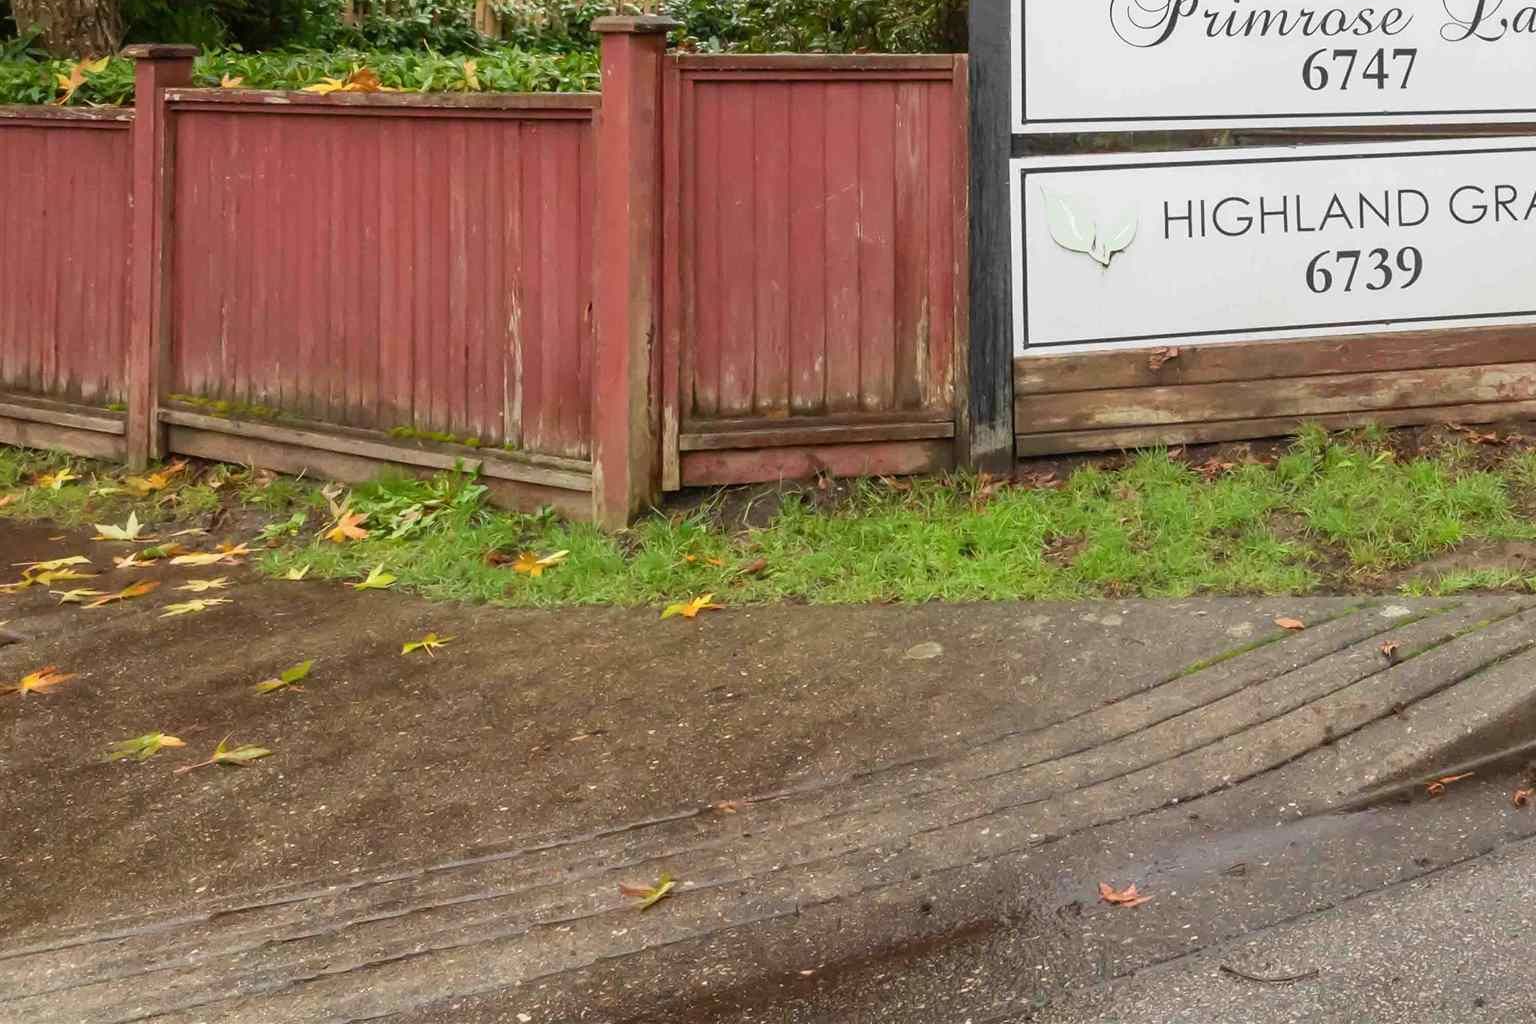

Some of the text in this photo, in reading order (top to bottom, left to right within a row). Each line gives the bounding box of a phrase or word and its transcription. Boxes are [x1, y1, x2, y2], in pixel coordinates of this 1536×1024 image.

[1302, 47, 1418, 91] 6747
[1163, 189, 1430, 240] HIGHLAND
[1305, 246, 1423, 294] 6739
